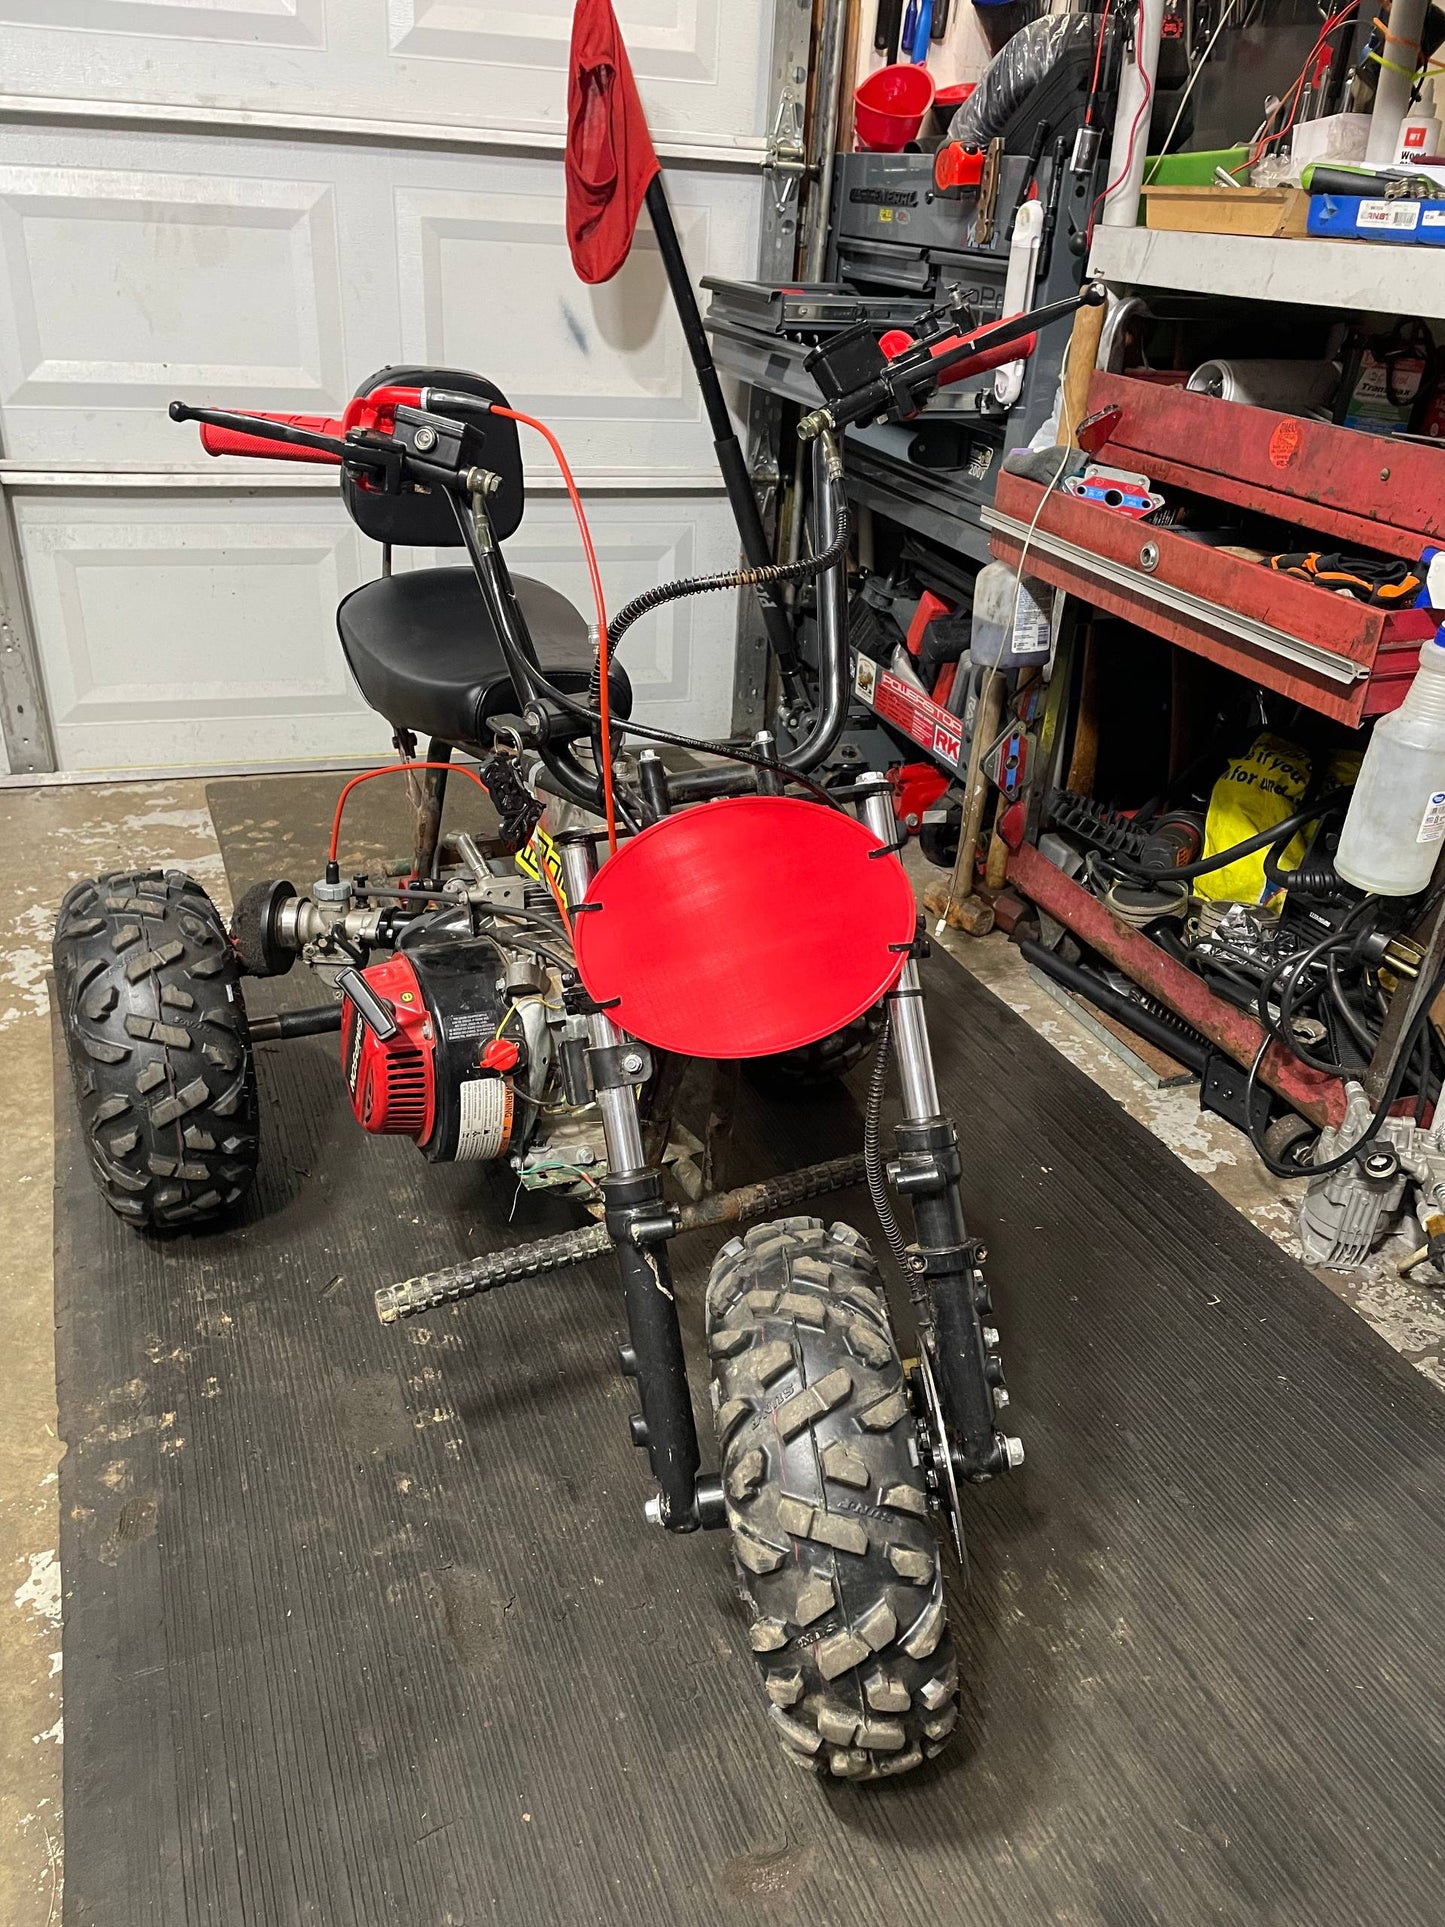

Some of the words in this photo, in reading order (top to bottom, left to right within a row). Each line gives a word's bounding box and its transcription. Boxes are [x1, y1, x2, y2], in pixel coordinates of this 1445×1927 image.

[882, 673, 962, 733] POWERSTOP
[935, 728, 960, 761] RK
[1229, 765, 1258, 786] for
